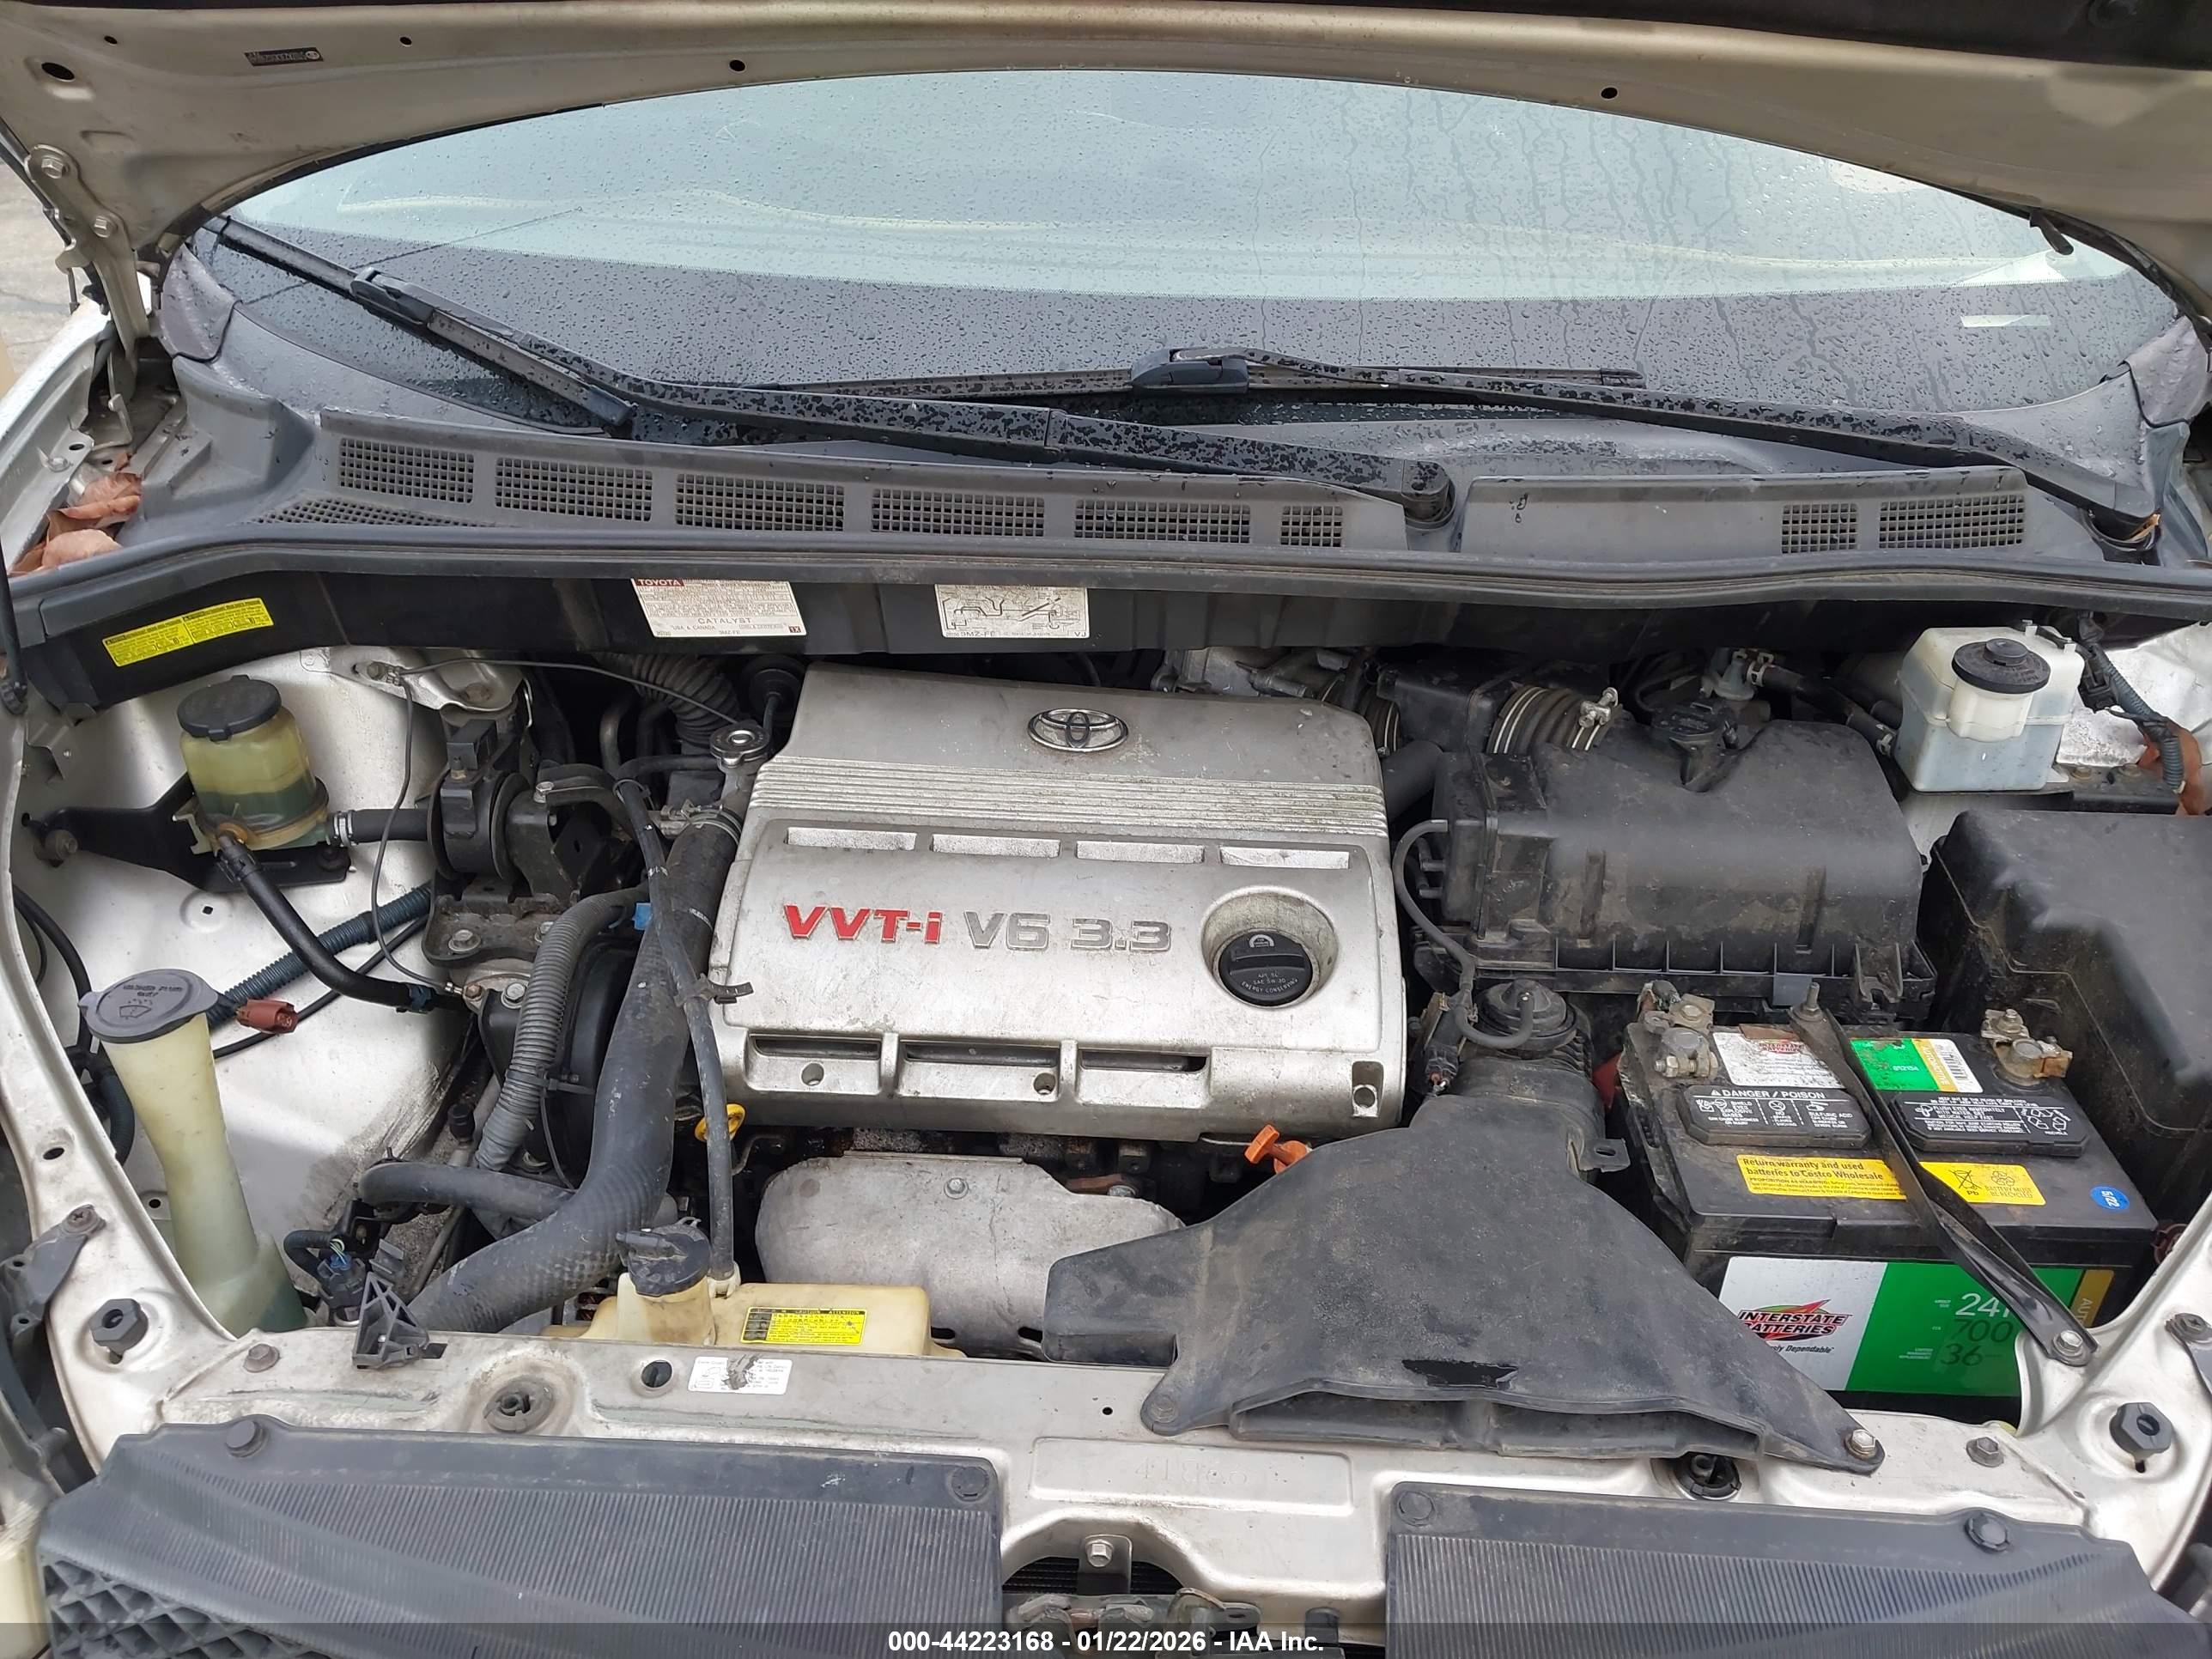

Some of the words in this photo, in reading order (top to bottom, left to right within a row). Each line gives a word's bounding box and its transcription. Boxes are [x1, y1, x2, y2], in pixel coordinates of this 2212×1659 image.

[783, 902, 943, 945] VVT-i
[963, 910, 1051, 951] V6
[1070, 917, 1172, 952] 3.3
[1722, 1089, 1770, 1097] DANGER
[1782, 1091, 1826, 1100] POISON
[1743, 1158, 1775, 1167] Return
[1778, 1160, 1820, 1170] warranty
[1821, 1161, 1839, 1170] and
[1841, 1162, 1864, 1170] used
[1747, 1168, 1789, 1177] batteries
[1789, 1169, 1800, 1177] to
[1801, 1170, 1832, 1179] Costco
[1834, 1170, 1884, 1181] Wholesale
[1739, 1311, 1846, 1325] INTERSTATE
[1954, 1318, 2014, 1343] 700
[1785, 1345, 1832, 1354] Dependable
